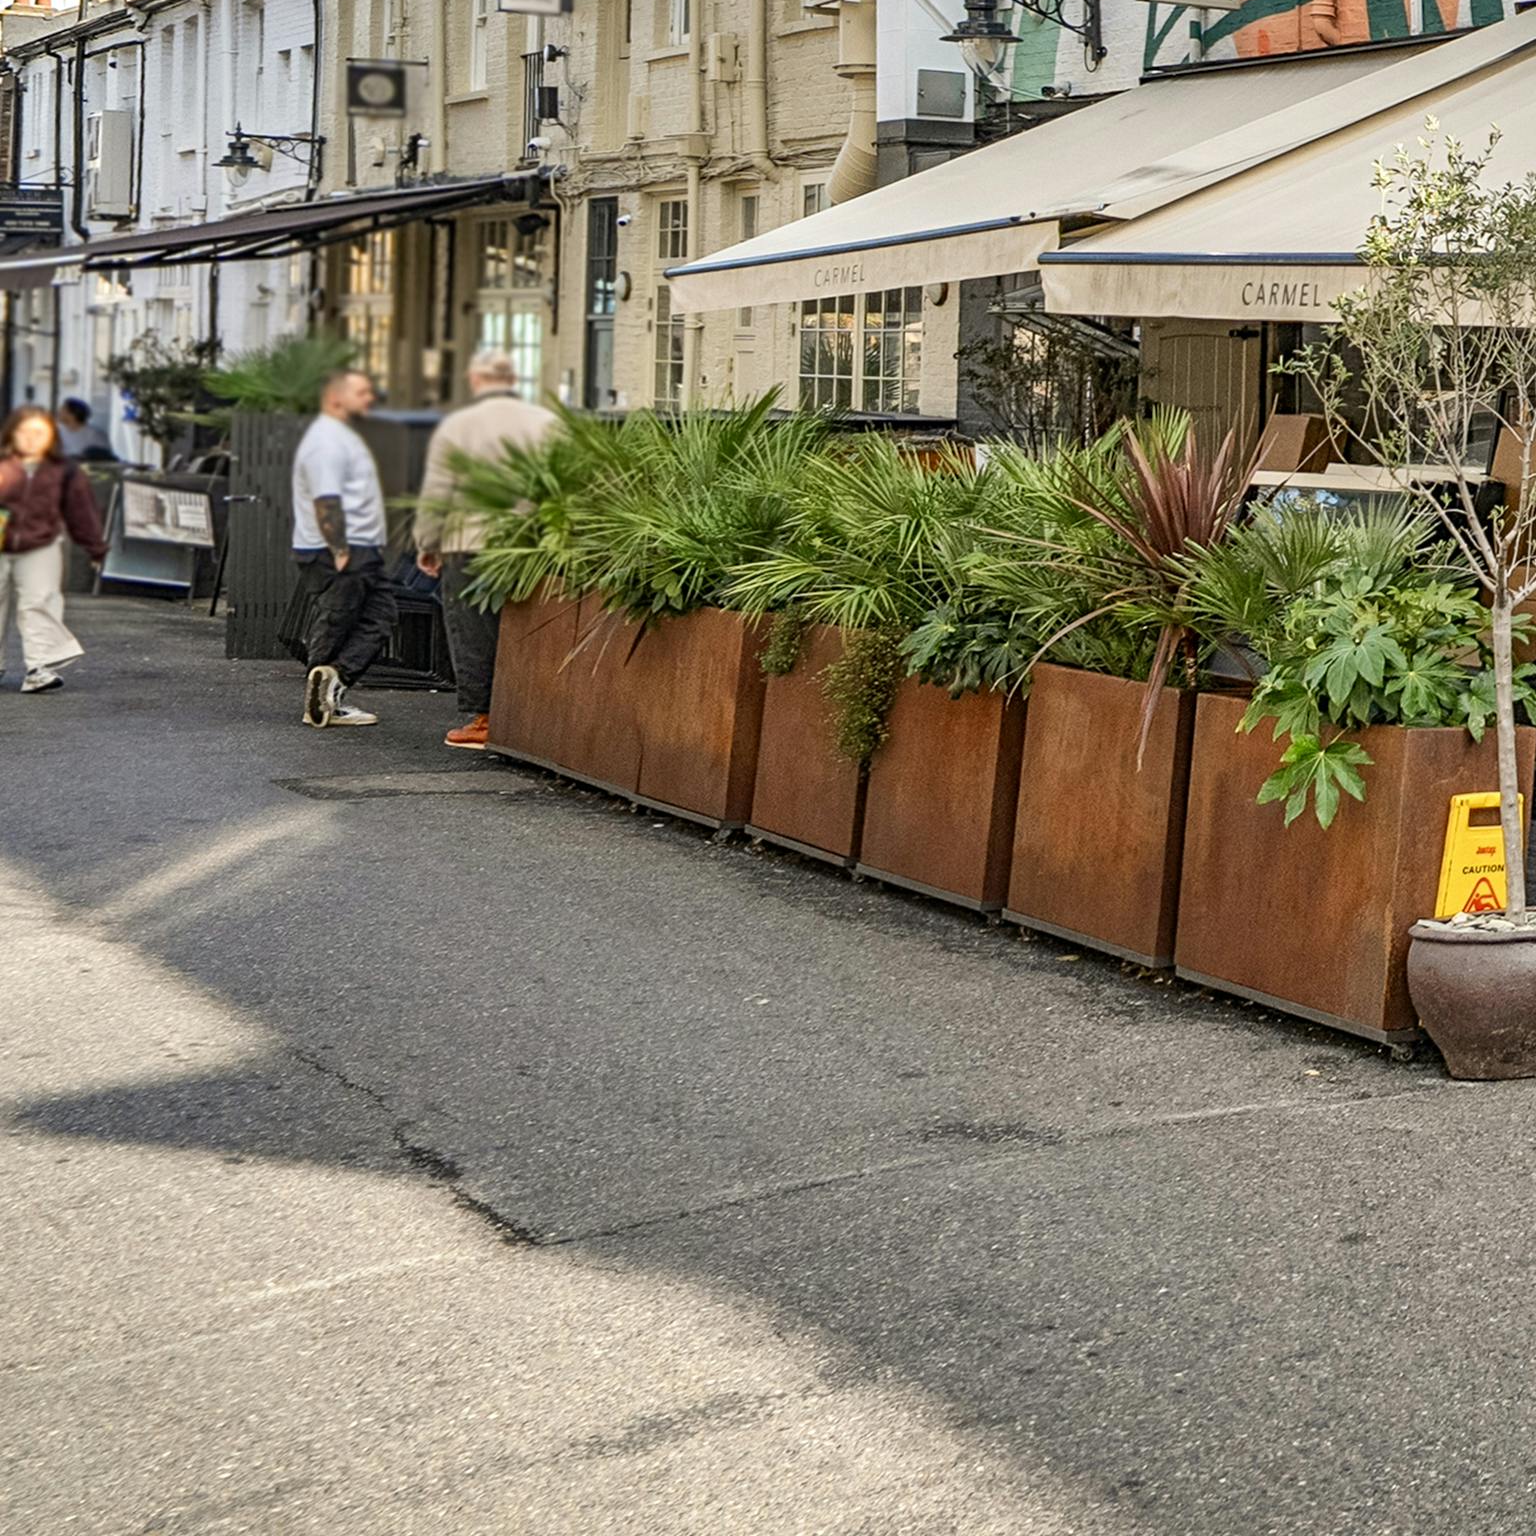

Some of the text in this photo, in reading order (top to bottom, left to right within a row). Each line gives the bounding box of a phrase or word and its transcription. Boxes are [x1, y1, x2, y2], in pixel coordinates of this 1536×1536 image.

[814, 264, 865, 287] CARMEL
[1241, 281, 1321, 307] CARMEL
[1462, 864, 1505, 875] CAUTION
